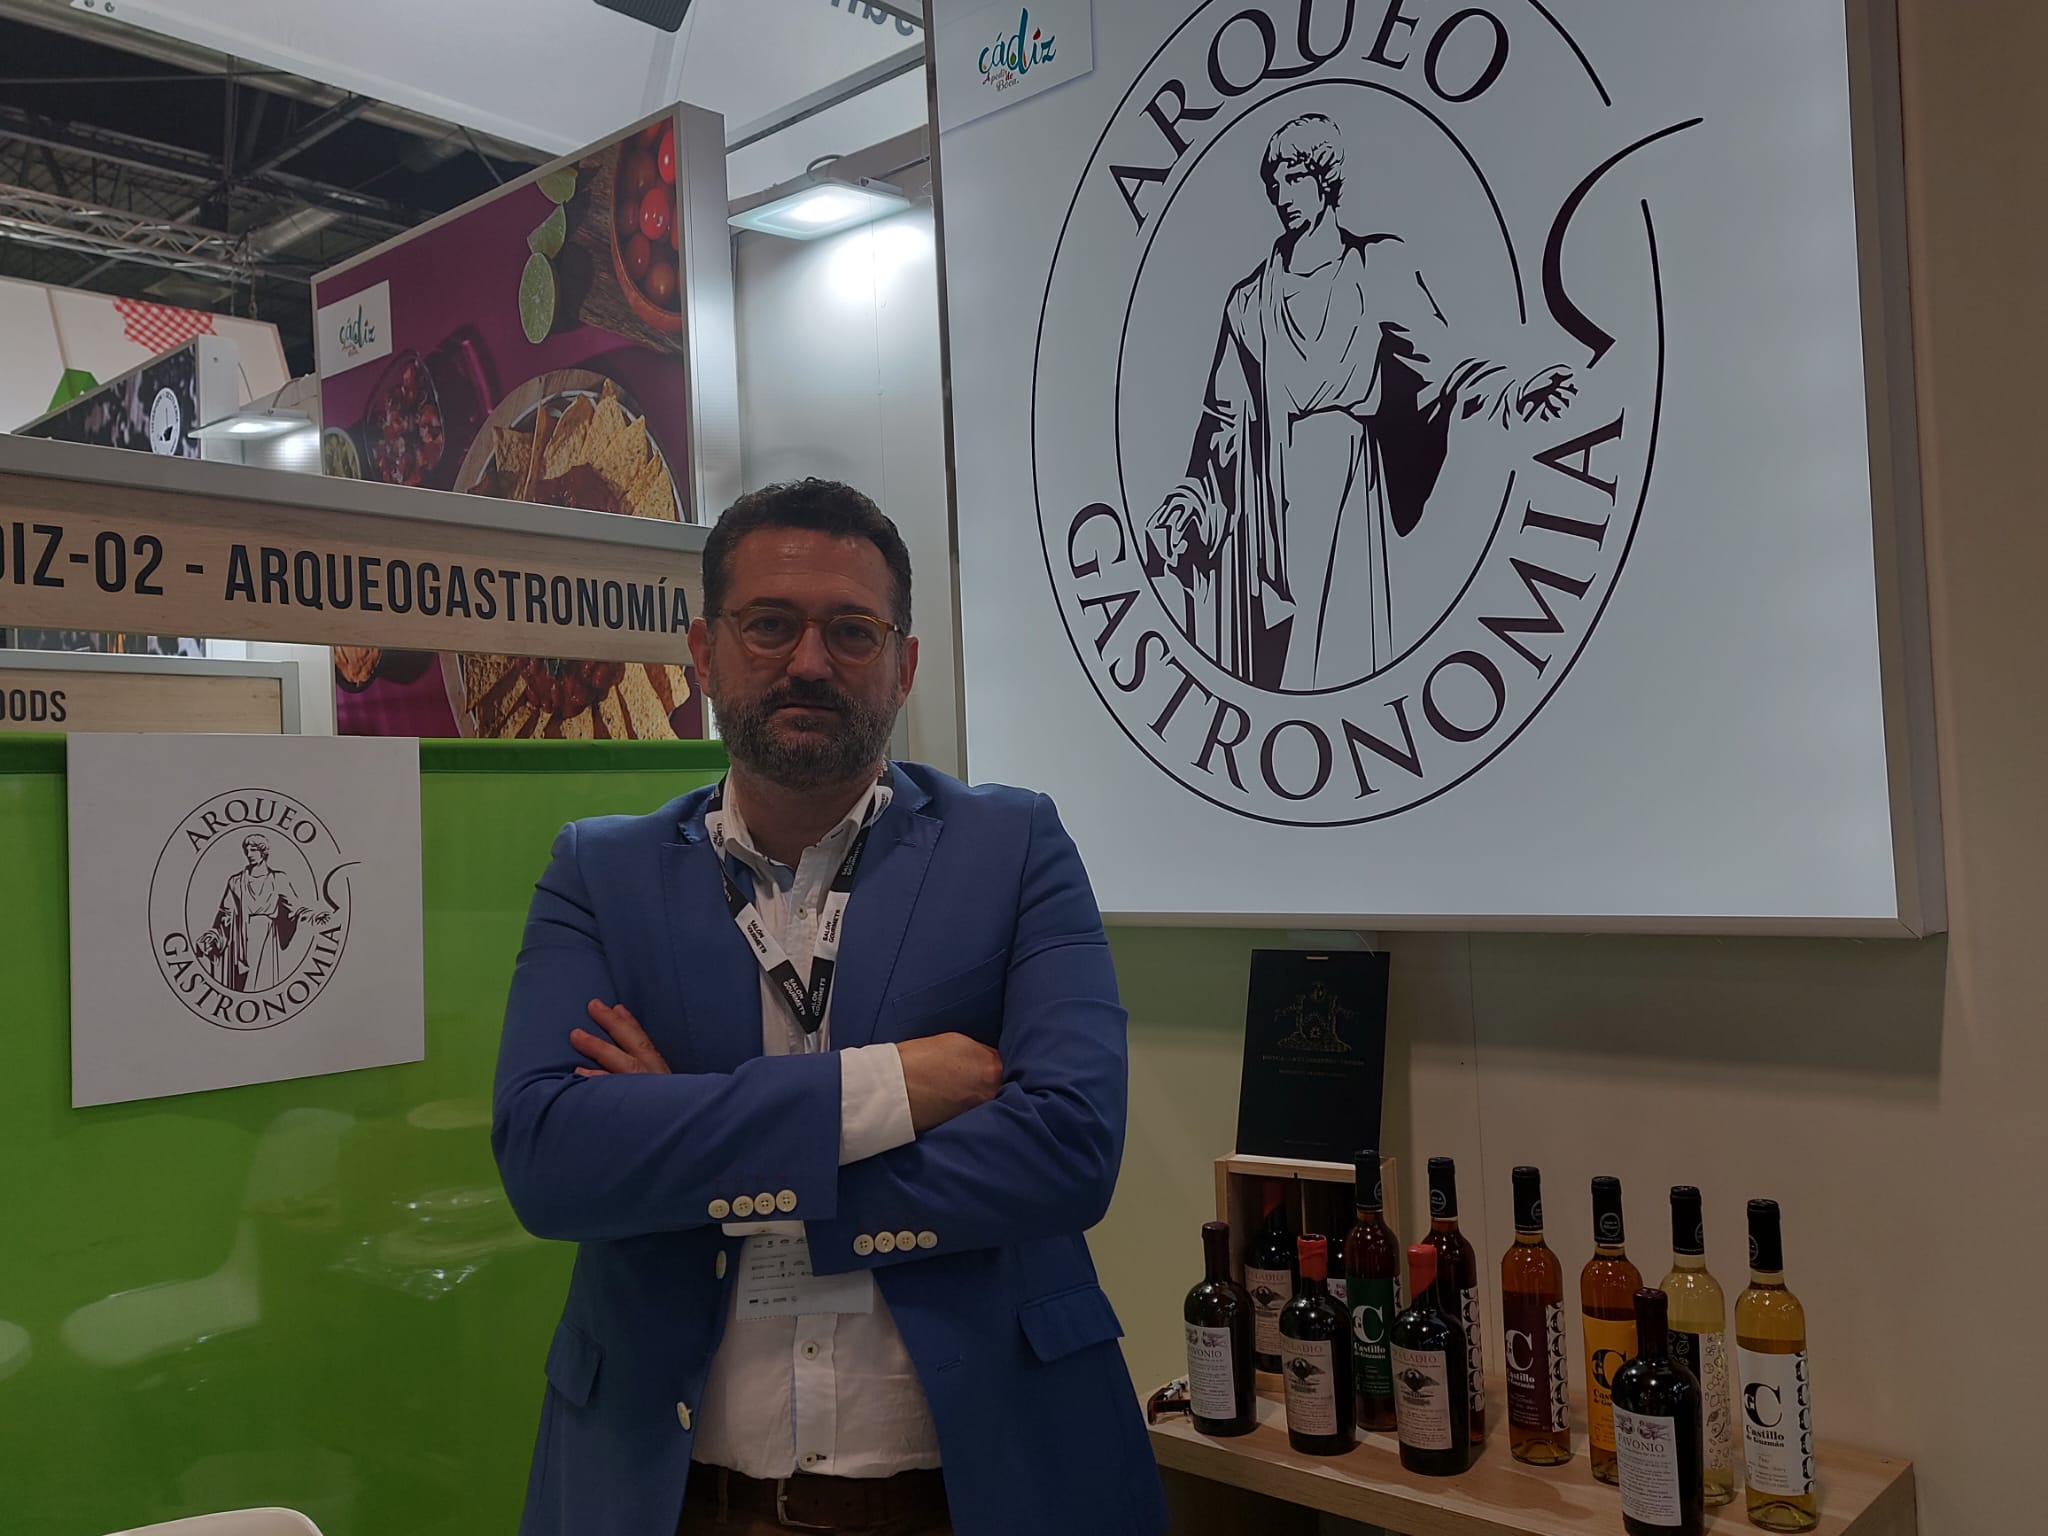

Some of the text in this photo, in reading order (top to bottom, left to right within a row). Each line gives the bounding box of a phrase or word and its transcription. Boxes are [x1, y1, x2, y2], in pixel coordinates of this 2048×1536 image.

[978, 8, 1057, 74] cádiz
[1108, 0, 1508, 235] ARQUEO
[0, 522, 164, 595] IZ-02
[225, 542, 690, 635] ARQUEOGASTRONOMÍA
[1067, 407, 1625, 802] GASTRONOMIA
[184, 797, 317, 853] ARQUEO
[162, 923, 342, 1024] GASTRONOMIA
[1745, 1424, 1785, 1440] Castillo
